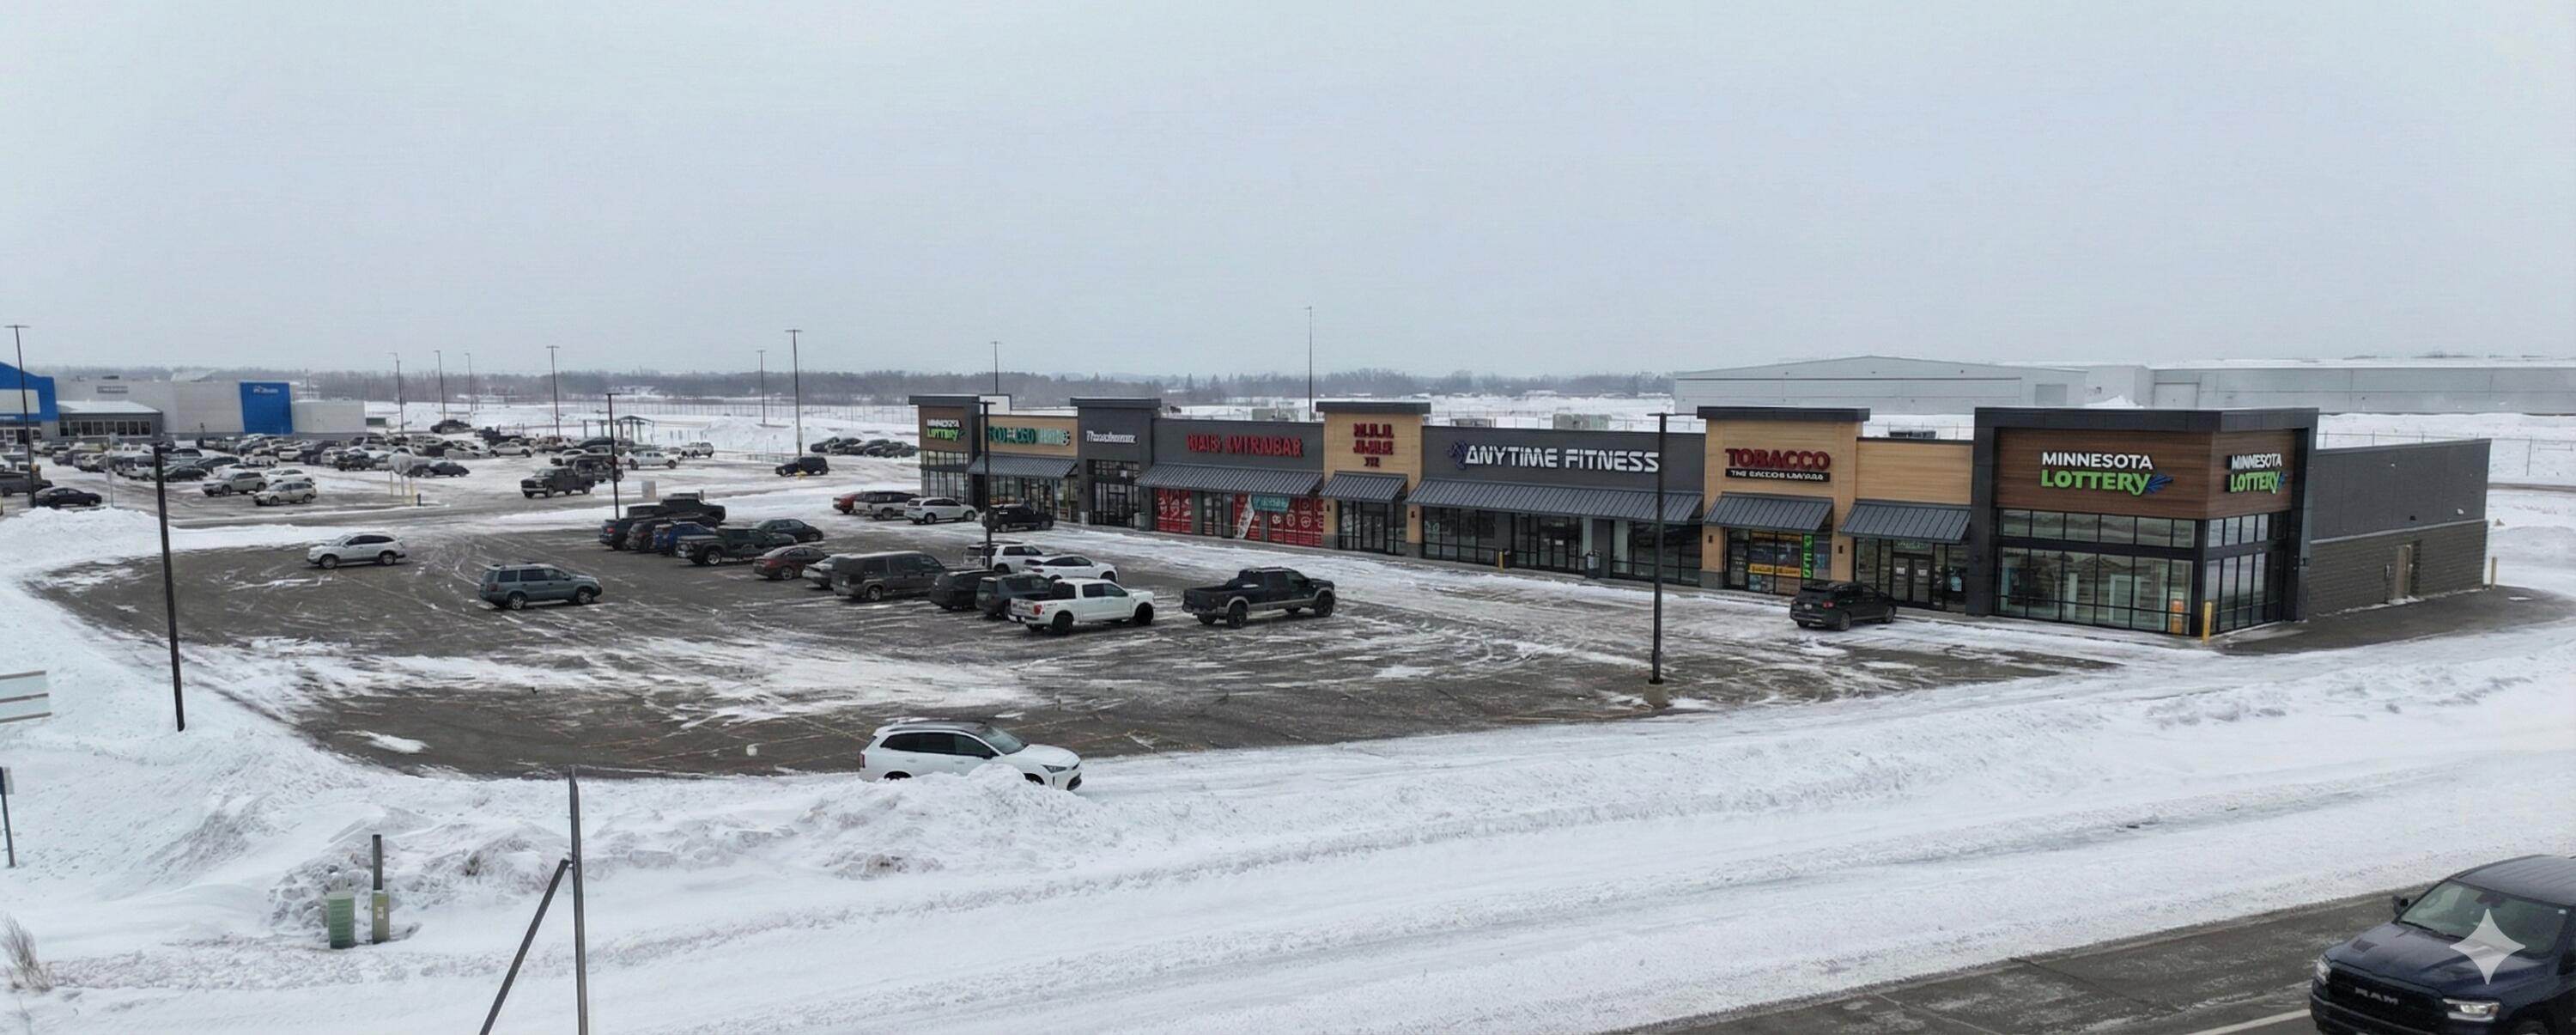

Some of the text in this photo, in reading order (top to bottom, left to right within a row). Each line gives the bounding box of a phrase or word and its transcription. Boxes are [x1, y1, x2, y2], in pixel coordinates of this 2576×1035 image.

[1465, 445, 1660, 472] ANYTIME FITNESS
[1724, 447, 1831, 472] TOBACCO
[2042, 451, 2154, 470] MINNESOTA
[2231, 453, 2282, 471] MINNESOTA
[2040, 469, 2151, 496] LOTTERY
[2230, 471, 2281, 494] LOTTERY
[2355, 987, 2399, 1005] RAM
